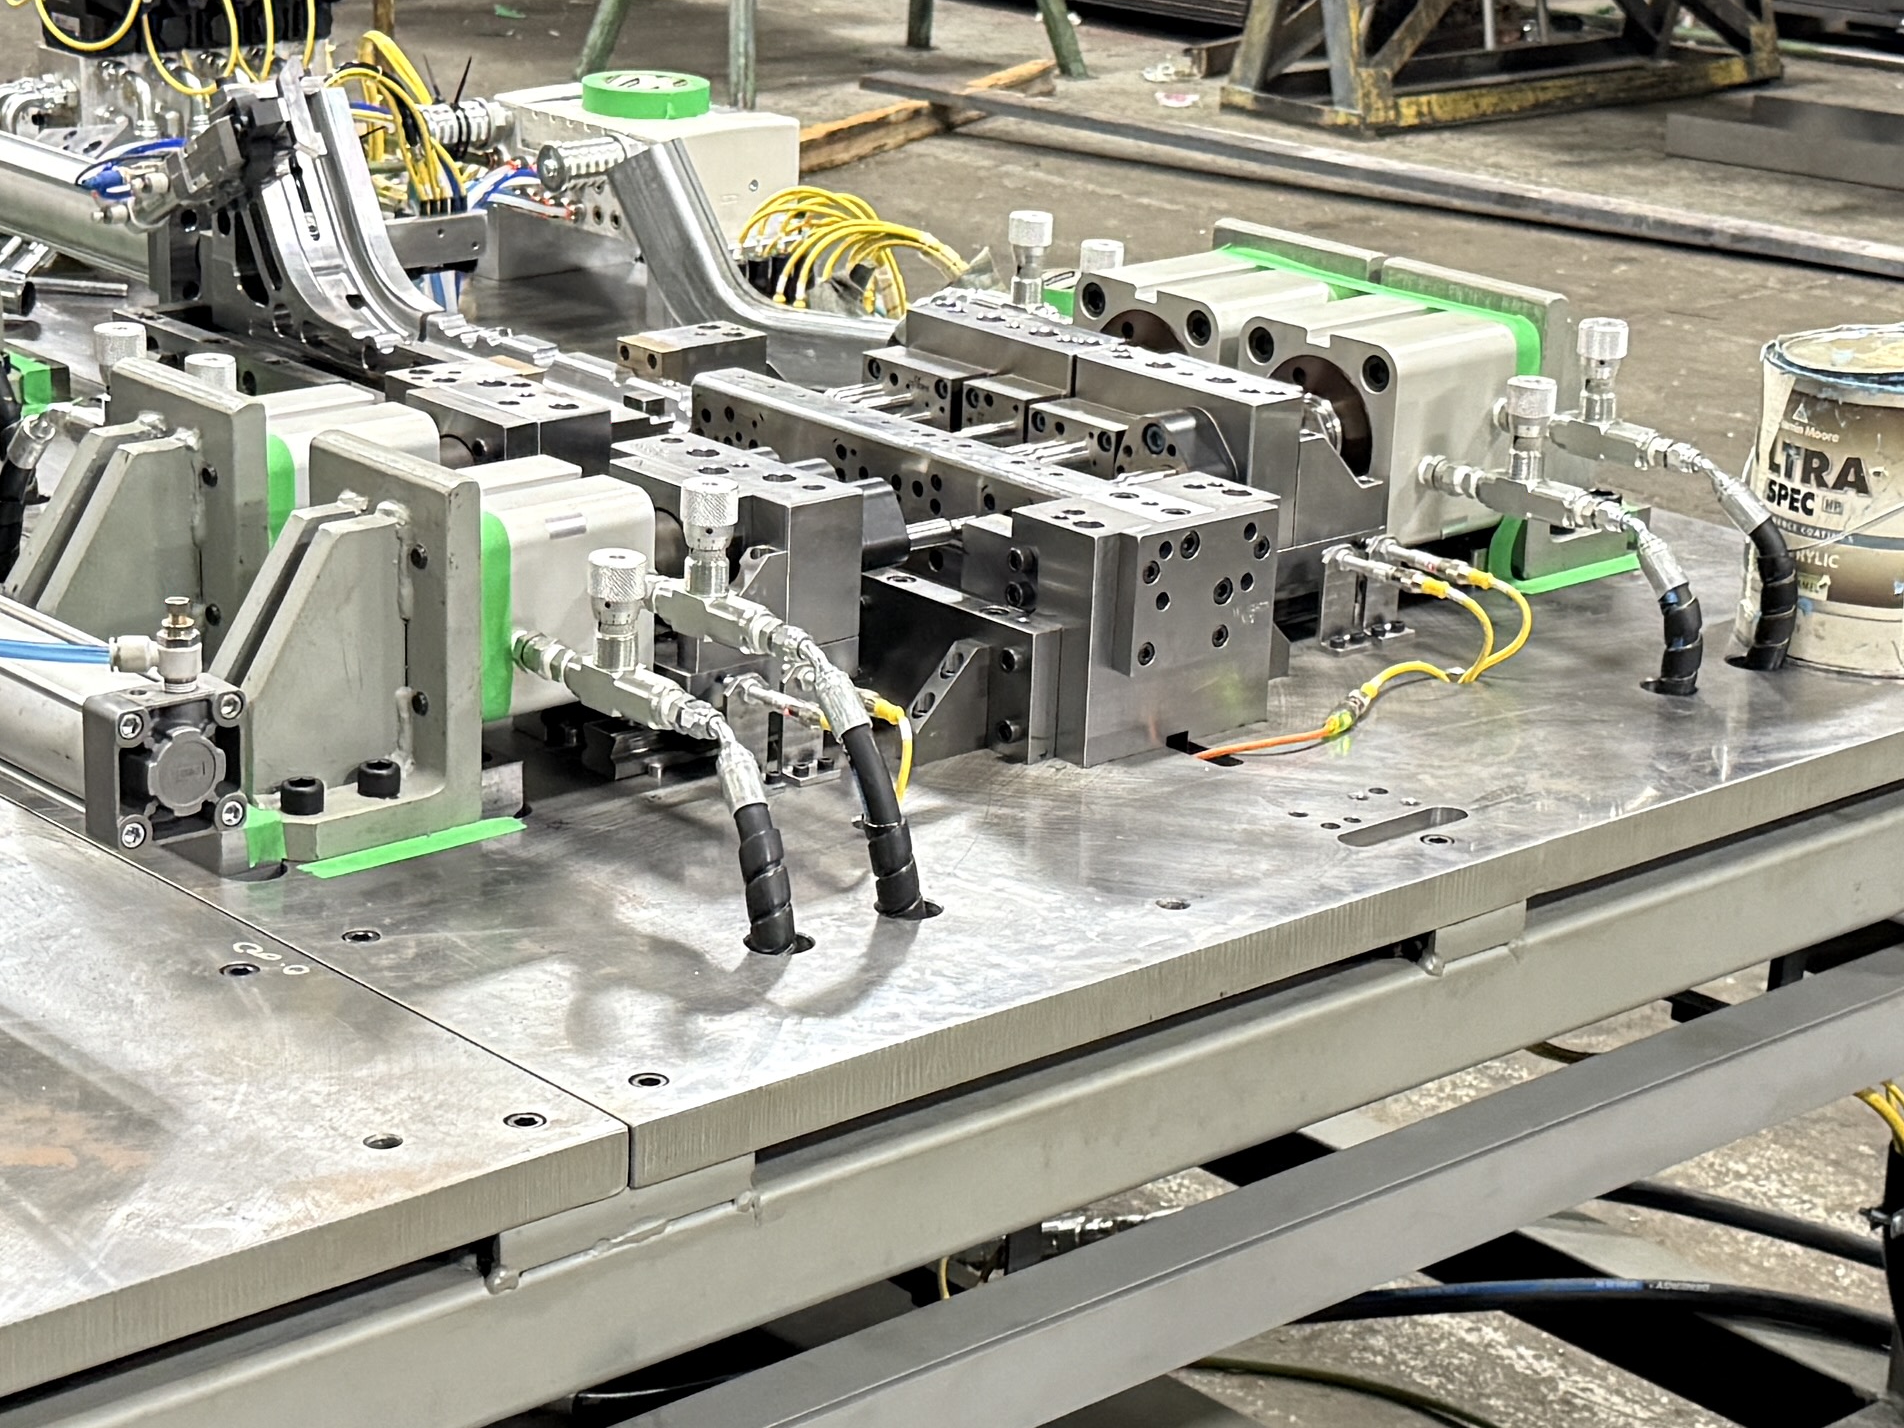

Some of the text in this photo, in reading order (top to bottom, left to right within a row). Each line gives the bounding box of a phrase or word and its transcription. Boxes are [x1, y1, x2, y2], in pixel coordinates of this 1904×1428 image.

[1804, 425, 1840, 443] Moore
[1768, 440, 1871, 495] LTRA
[1765, 479, 1816, 517] SPEC
[1801, 526, 1854, 545] COATINS
[1795, 550, 1840, 569] RYLIC
